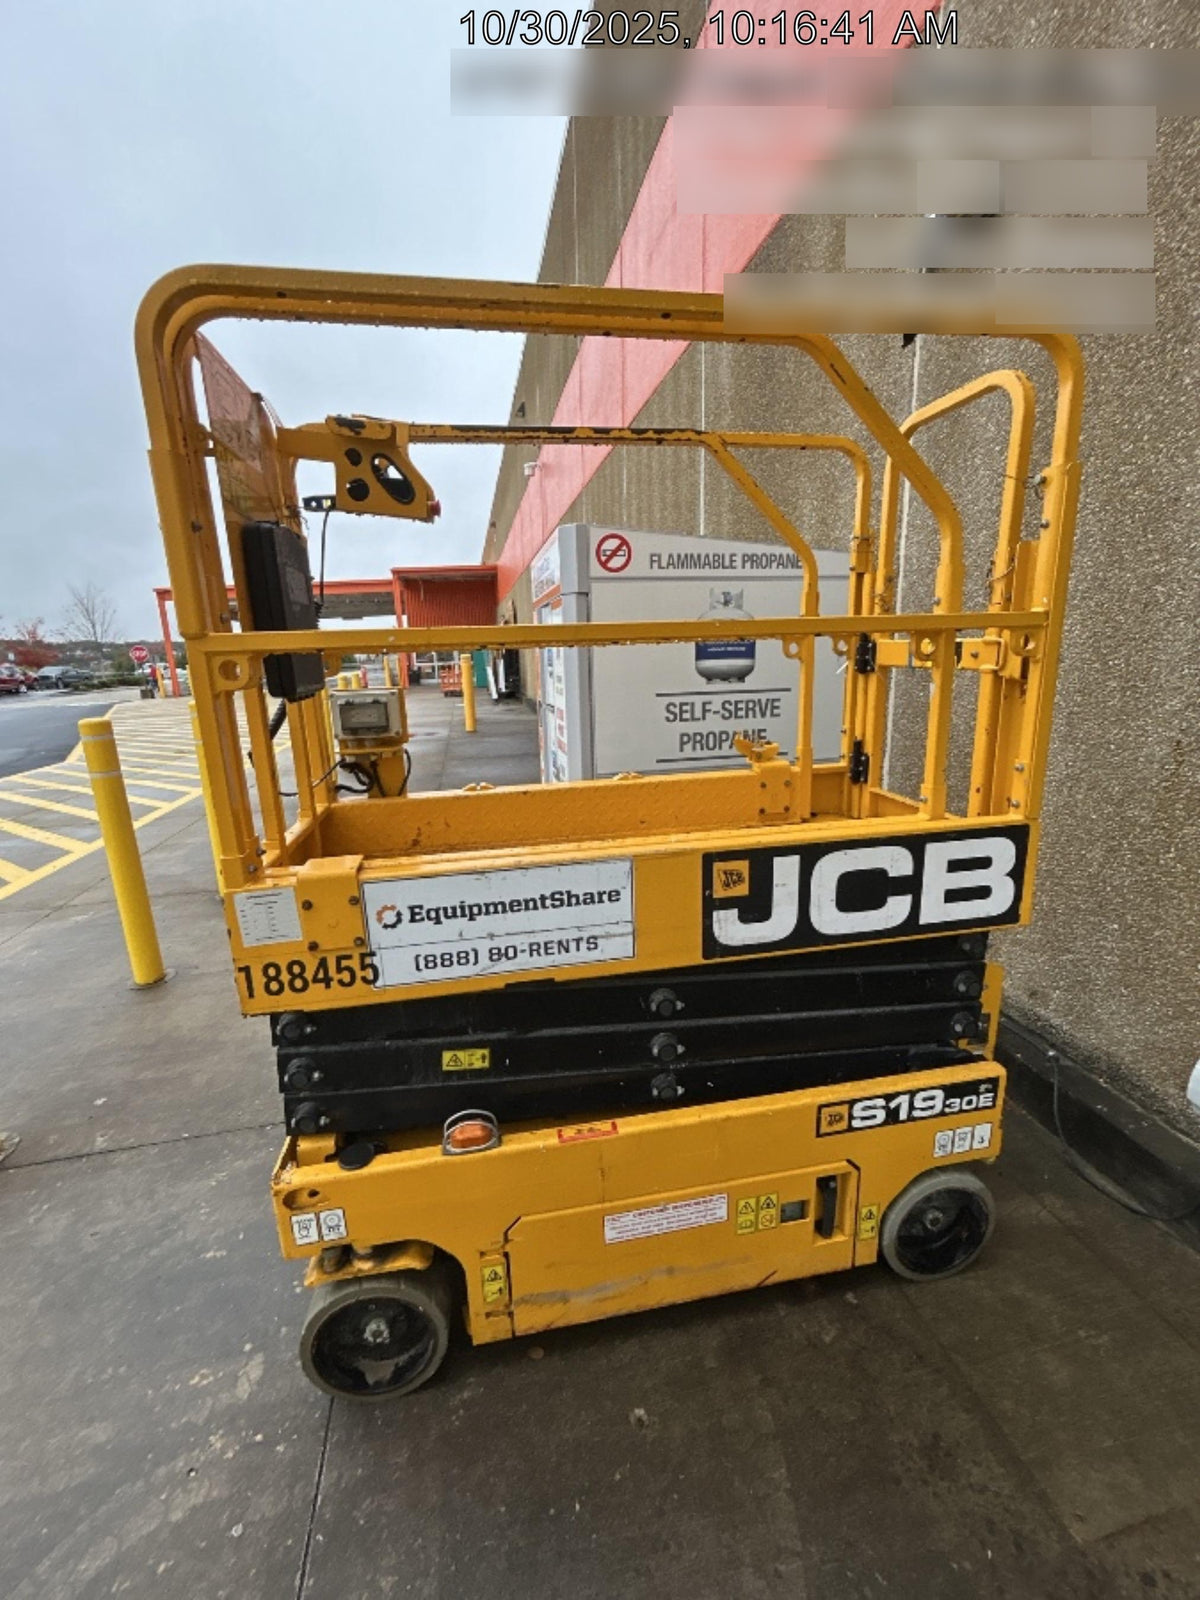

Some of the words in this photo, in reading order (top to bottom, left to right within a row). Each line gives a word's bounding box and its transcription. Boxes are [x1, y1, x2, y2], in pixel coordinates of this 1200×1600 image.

[649, 552, 738, 571] FLAMMABLE
[665, 697, 781, 723] SELF-SERVE
[408, 887, 622, 928] EquipmentShare
[712, 836, 1016, 947] JCB
[414, 950, 480, 974] (888)
[487, 935, 600, 965] 80-RENTS
[238, 951, 380, 1000] 188455
